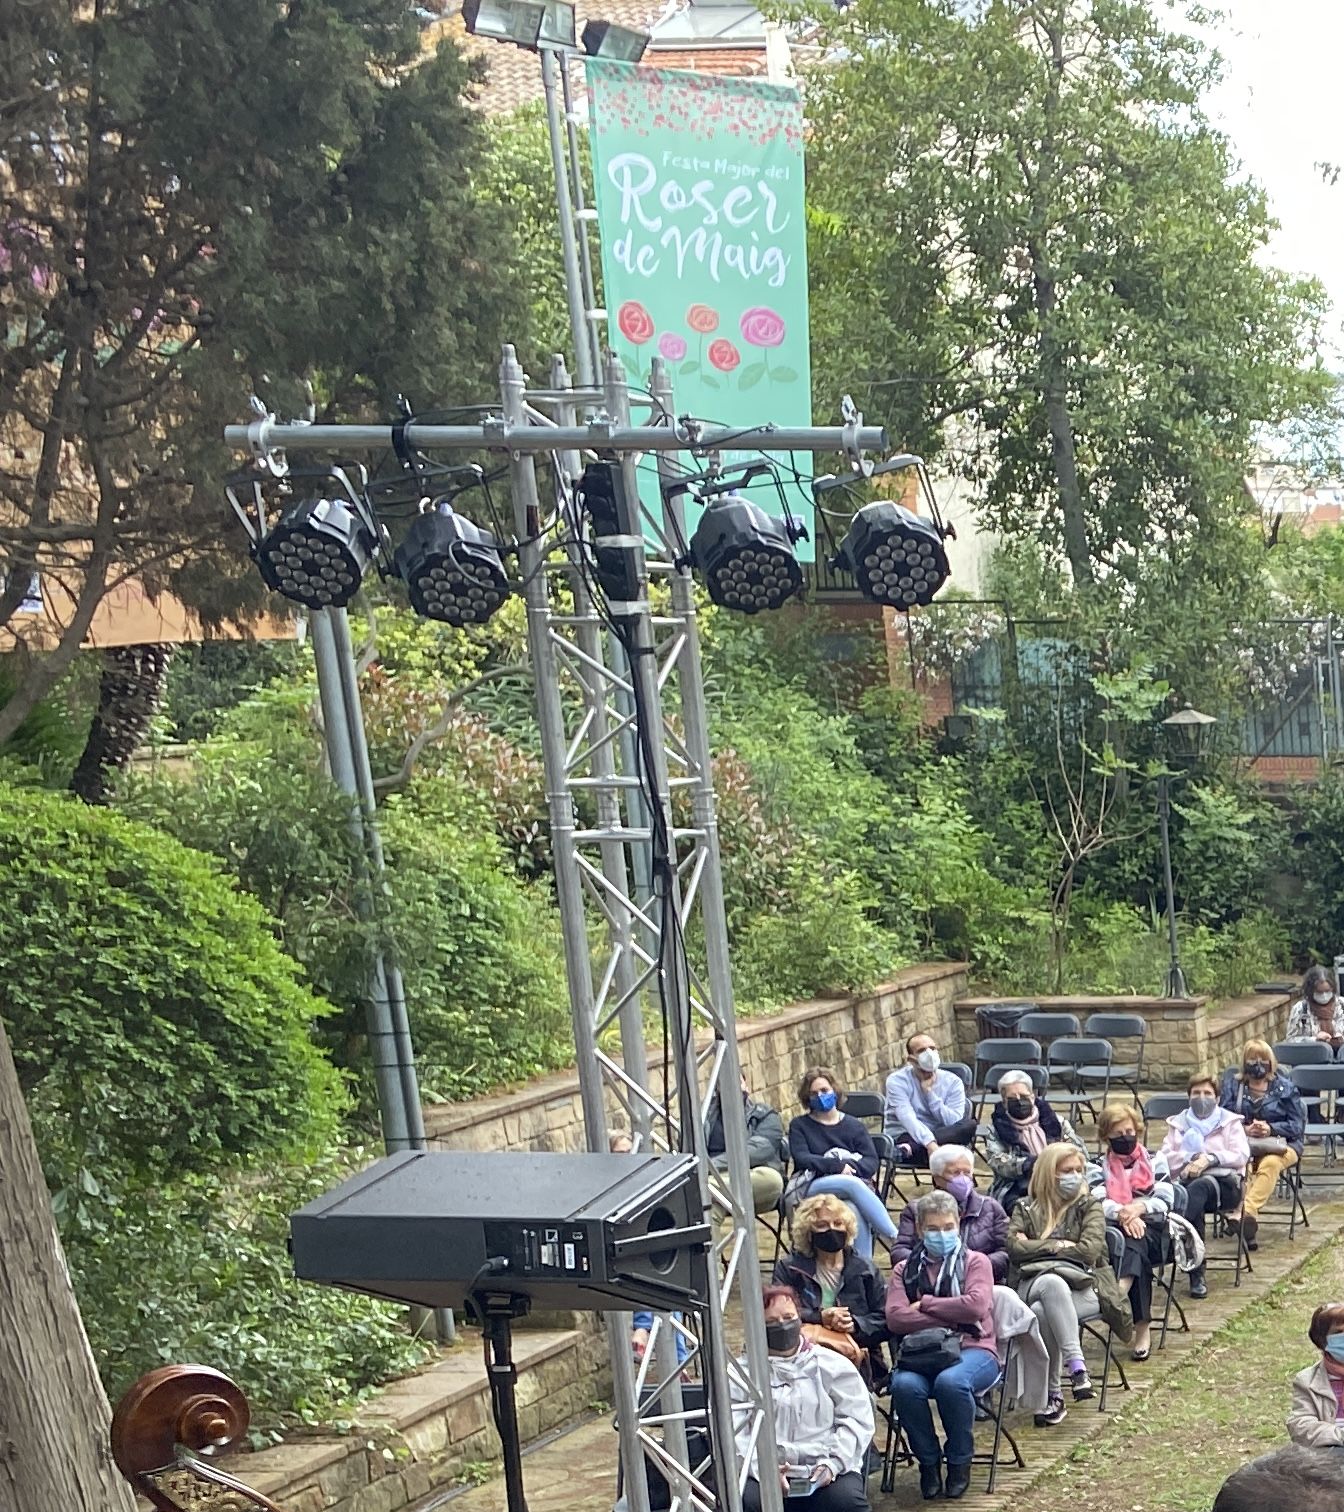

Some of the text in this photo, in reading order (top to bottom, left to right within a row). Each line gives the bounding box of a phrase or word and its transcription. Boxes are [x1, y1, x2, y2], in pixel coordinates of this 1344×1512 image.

[607, 152, 791, 234] Roser
[662, 151, 790, 180] Festa Major del
[613, 226, 791, 288] de Maig
